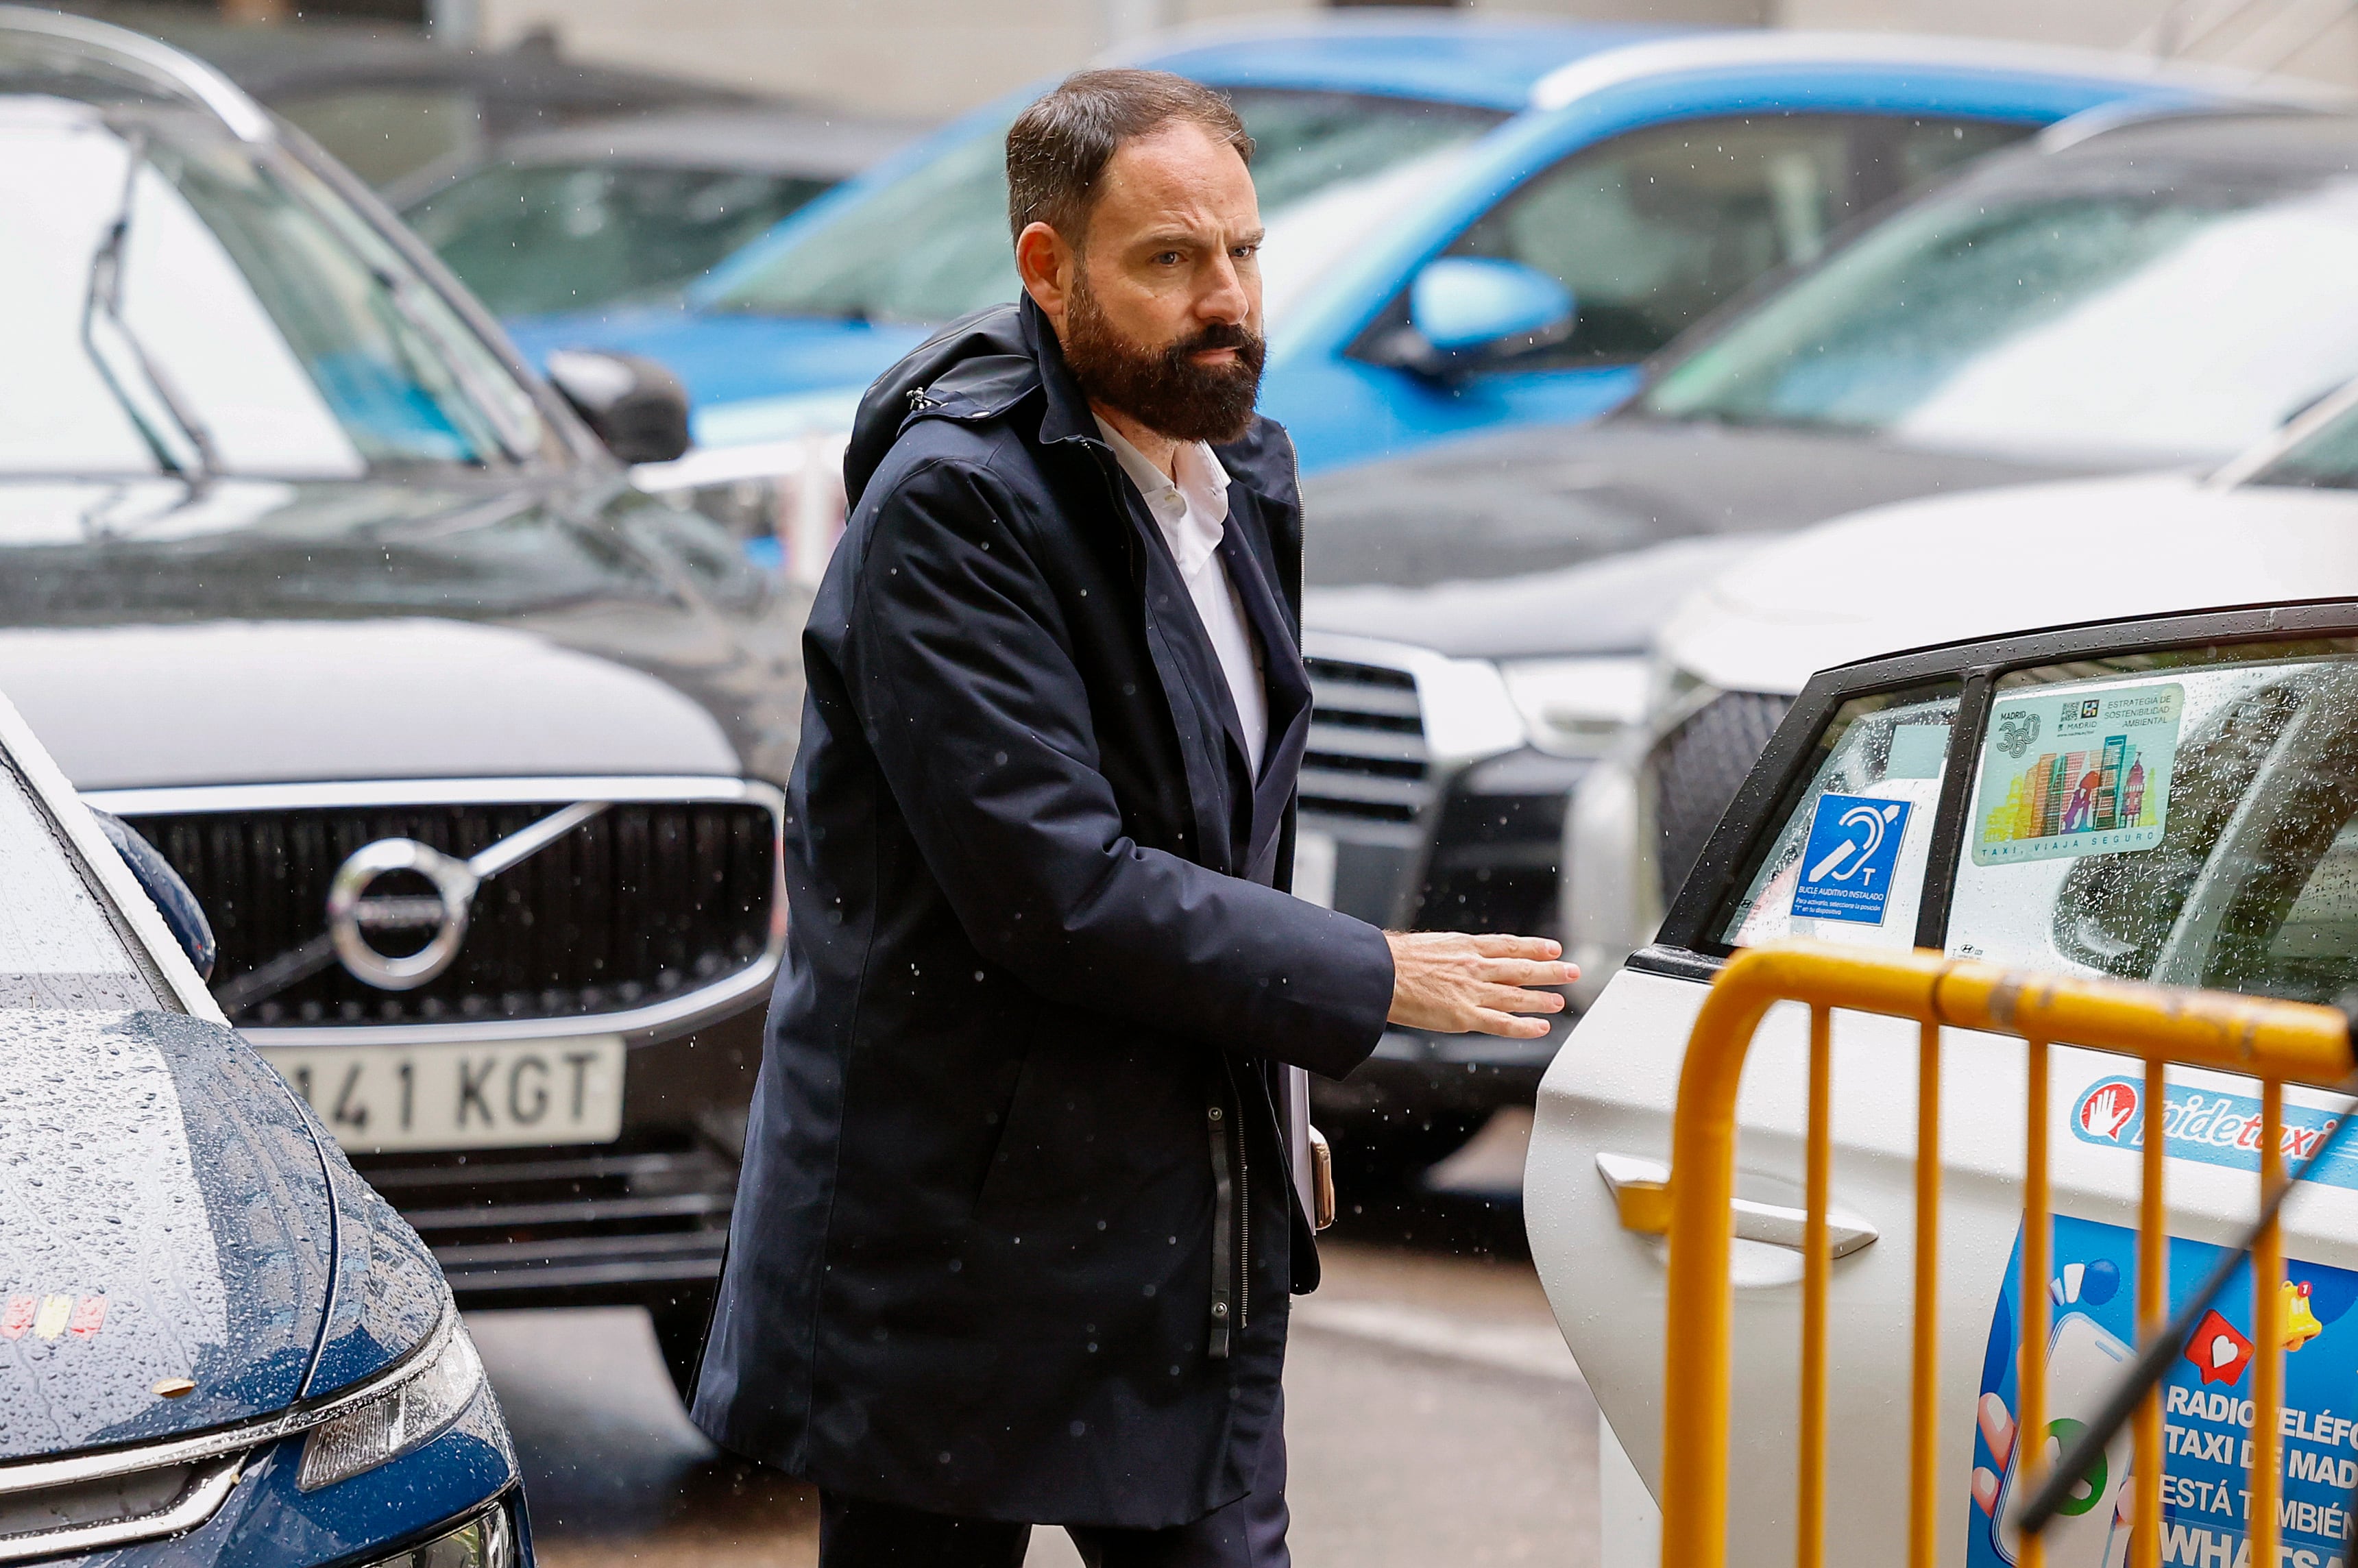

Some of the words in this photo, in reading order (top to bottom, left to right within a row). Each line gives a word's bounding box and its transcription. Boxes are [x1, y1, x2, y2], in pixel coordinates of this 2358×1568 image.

[2107, 696, 2159, 709] ESTRATEGIA
[2160, 695, 2172, 704] DE
[2000, 710, 2027, 720] MADRID
[2104, 706, 2170, 720] SOSTENIBILIDAD
[2067, 721, 2098, 730] MADRID
[2122, 717, 2168, 728] AMBIENTAL
[1996, 713, 2041, 759] 360
[2034, 840, 2080, 853] VIAJA
[2091, 831, 2154, 846] SEGURO
[1798, 885, 1819, 894] BUCLE
[1818, 887, 1849, 897] AUDITIVO
[1849, 890, 1884, 901] INSTALADO
[455, 1050, 598, 1129] KGT
[2163, 1423, 2235, 1465] TAXI
[2159, 1473, 2233, 1517] ESTÁ
[2238, 1489, 2355, 1541] TMBIÉN
